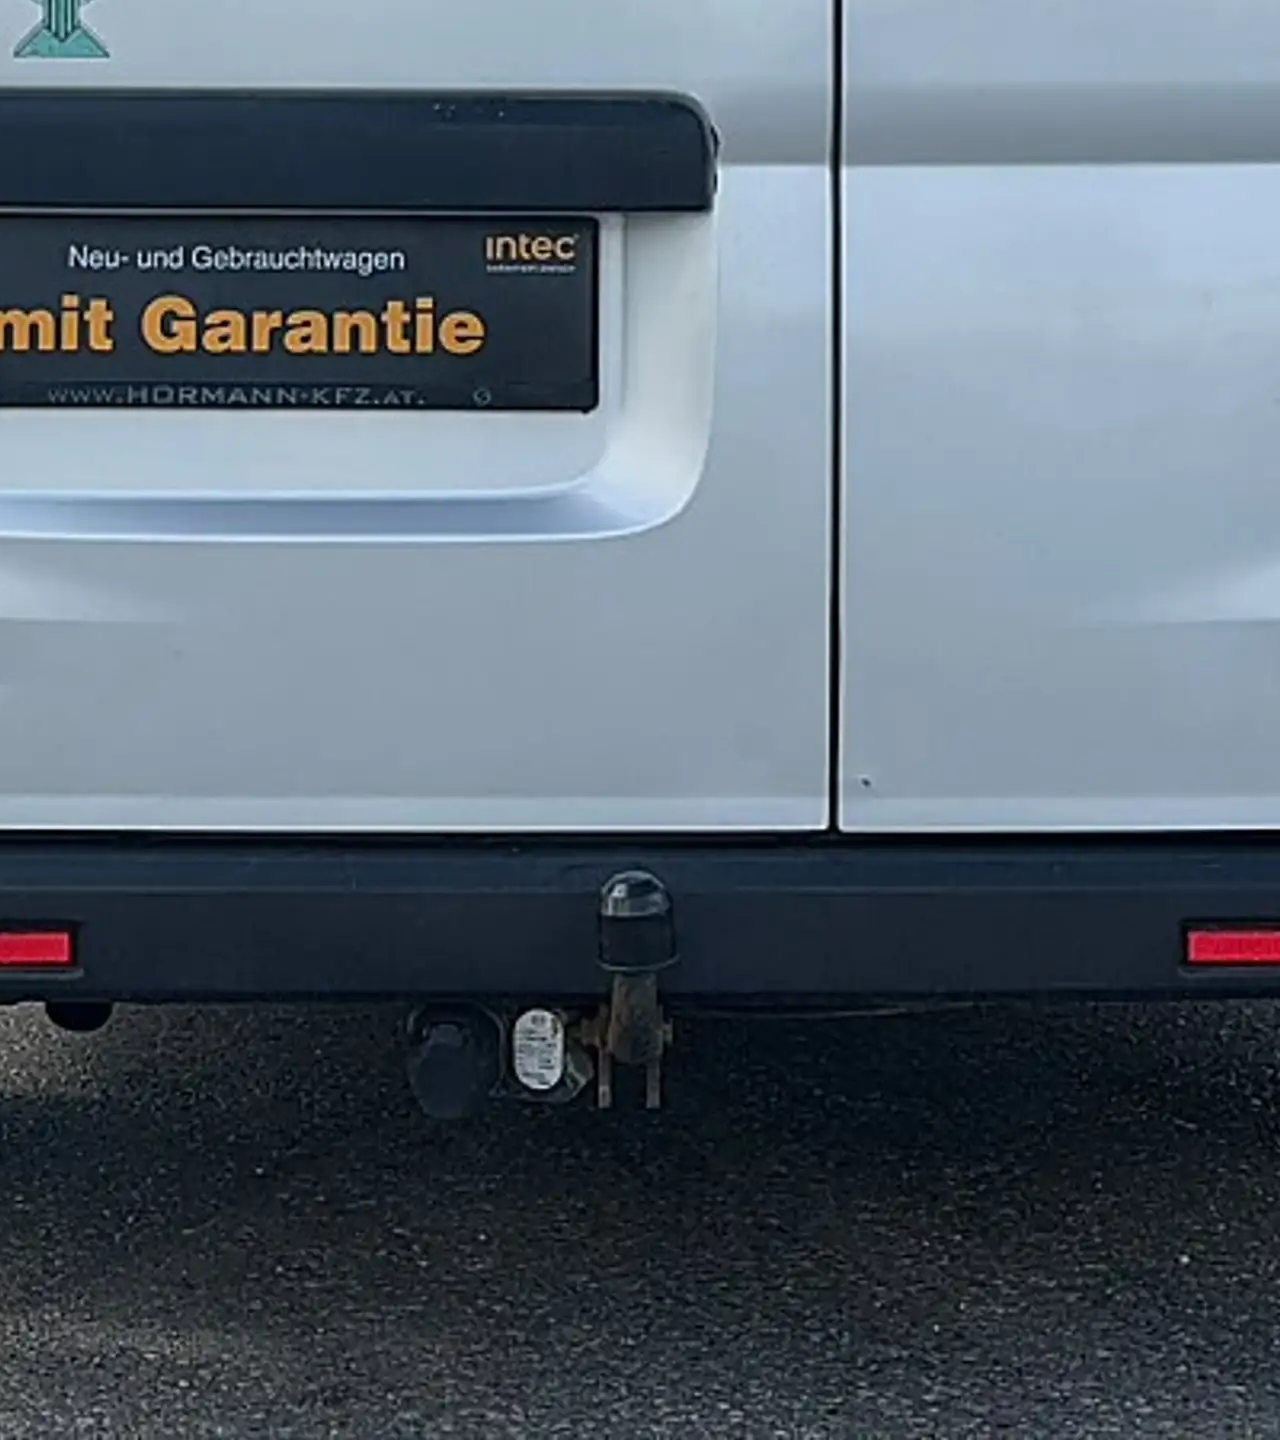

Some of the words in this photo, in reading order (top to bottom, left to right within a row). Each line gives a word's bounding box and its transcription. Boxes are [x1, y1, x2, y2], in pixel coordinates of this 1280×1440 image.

[69, 245, 129, 269] Neu-
[137, 246, 183, 269] und
[191, 245, 405, 275] Gebrauchtwagen
[486, 233, 575, 260] intec
[141, 295, 485, 354] Garantie
